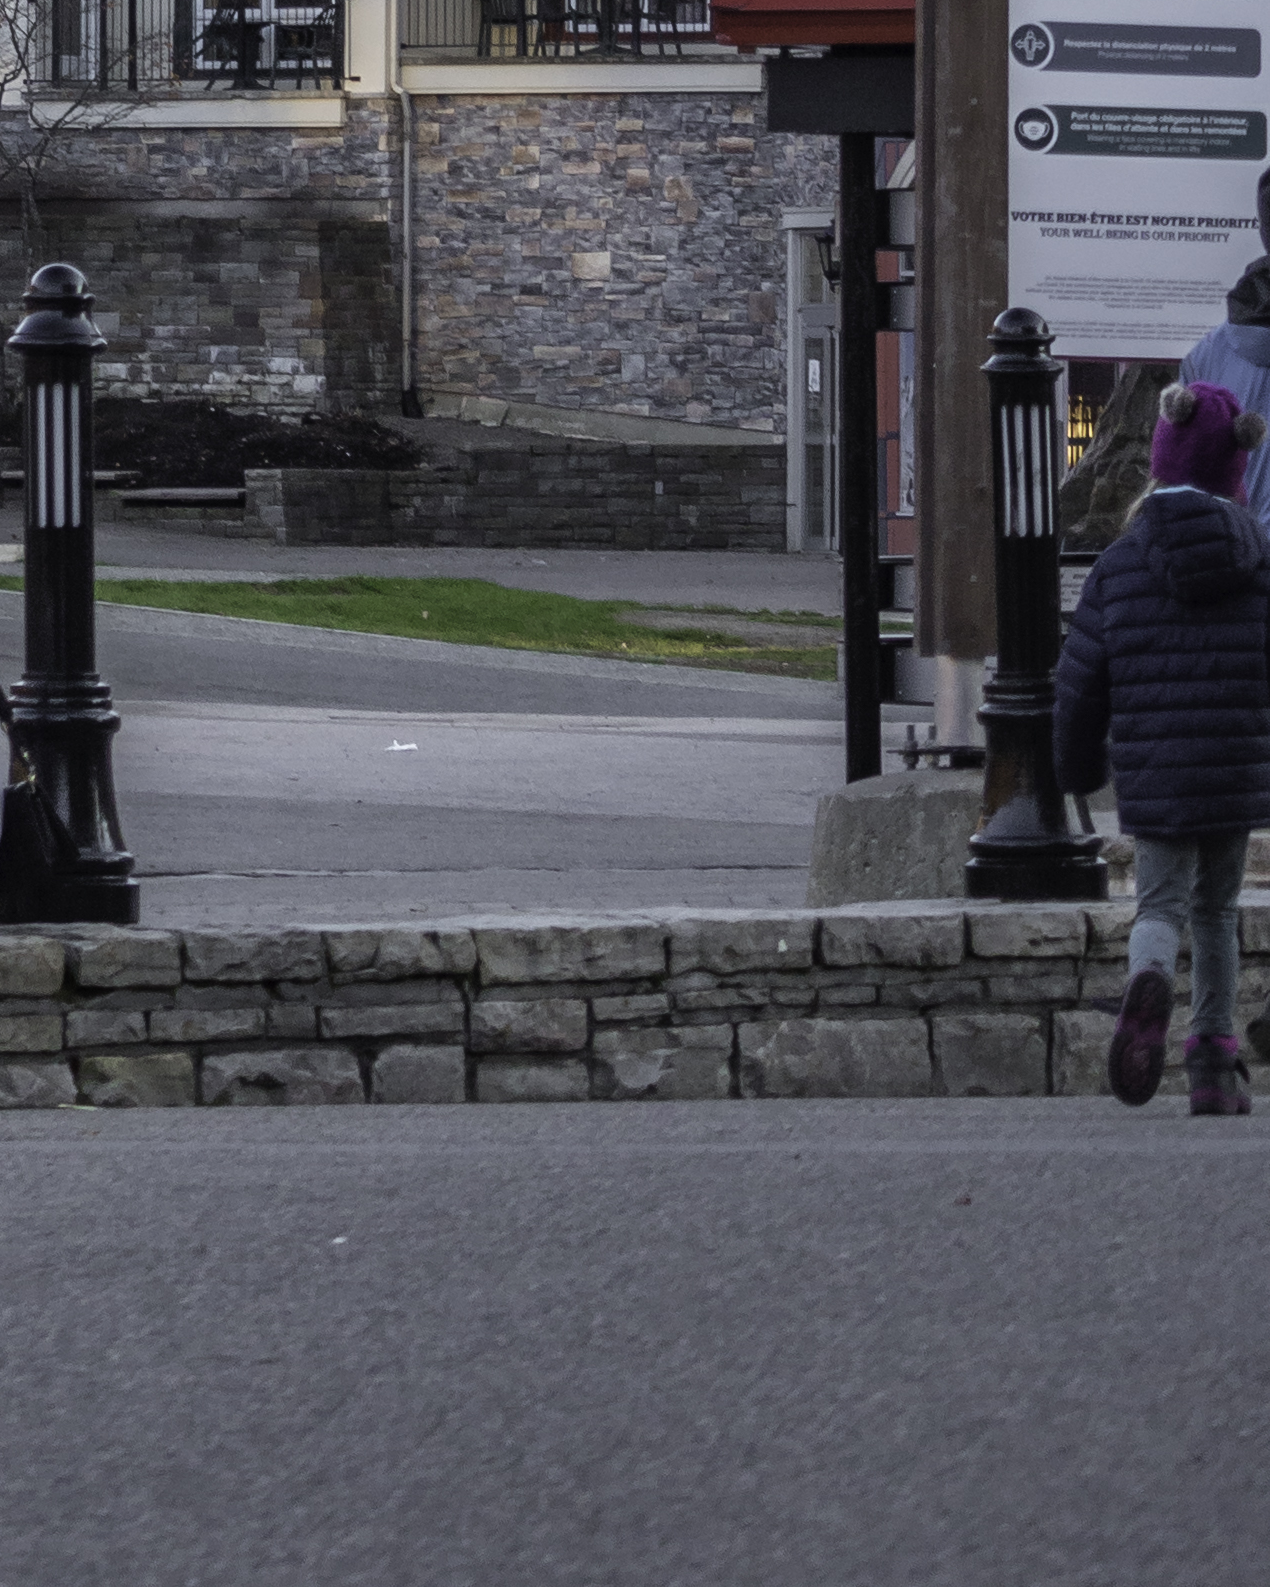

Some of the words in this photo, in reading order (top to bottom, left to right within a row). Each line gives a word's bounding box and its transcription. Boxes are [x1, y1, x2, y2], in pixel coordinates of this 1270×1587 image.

[1011, 211, 1054, 223] VOTRE
[1056, 211, 1124, 225] BIEN-ÊTRE
[1125, 214, 1149, 225] EST
[1151, 215, 1195, 227] NOTRE
[1197, 215, 1259, 229] PRIORITÉ
[1040, 227, 1070, 238] YOUR
[1072, 228, 1139, 240] WELL-BEING
[1140, 230, 1151, 241] IS
[1152, 230, 1176, 242] OUR
[1177, 231, 1230, 243] PRIORITY
